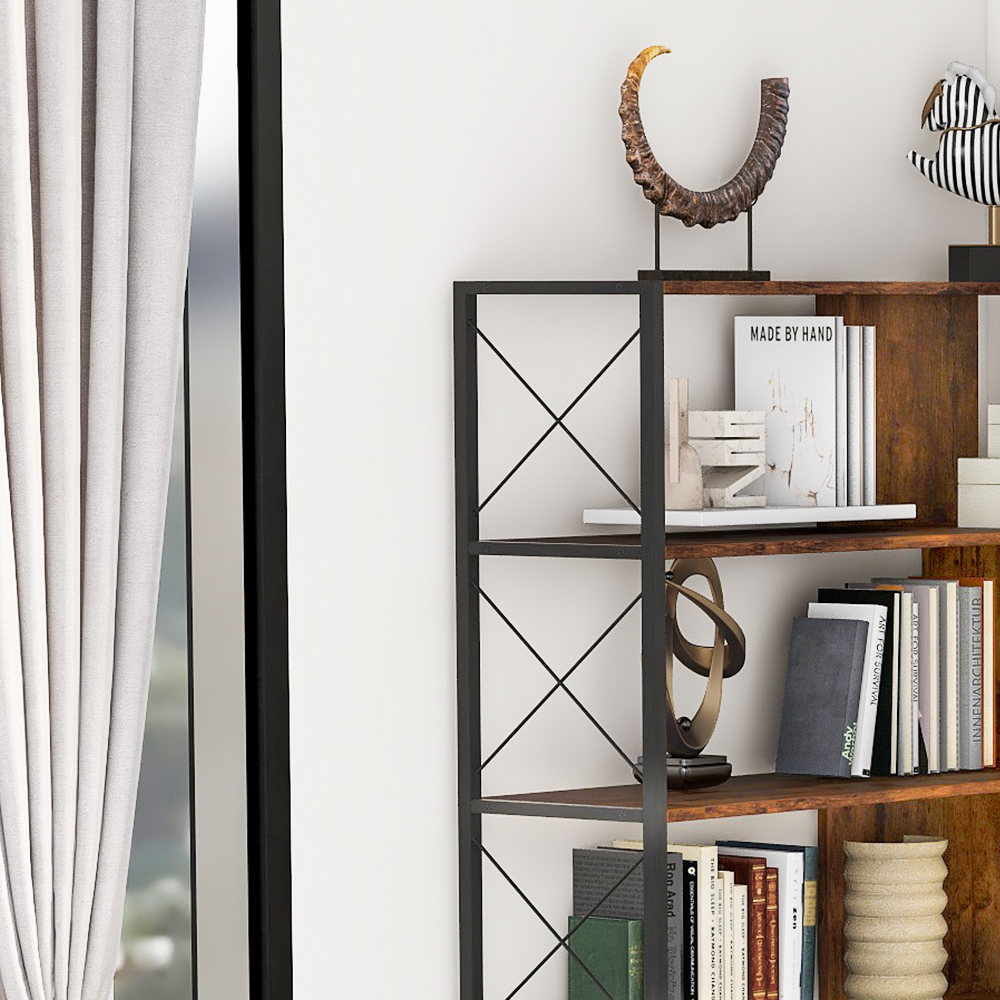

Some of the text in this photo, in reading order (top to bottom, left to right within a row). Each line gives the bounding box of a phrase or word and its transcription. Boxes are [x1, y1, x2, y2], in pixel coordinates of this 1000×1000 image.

[750, 326, 833, 342] MADE BY HAND
[870, 615, 887, 706] ART FOR SURVIVAL
[971, 597, 983, 744] INNENARCHITEKTUR
[841, 725, 854, 760] Andy
[667, 862, 677, 889] Ron
[667, 891, 677, 918] Arad
